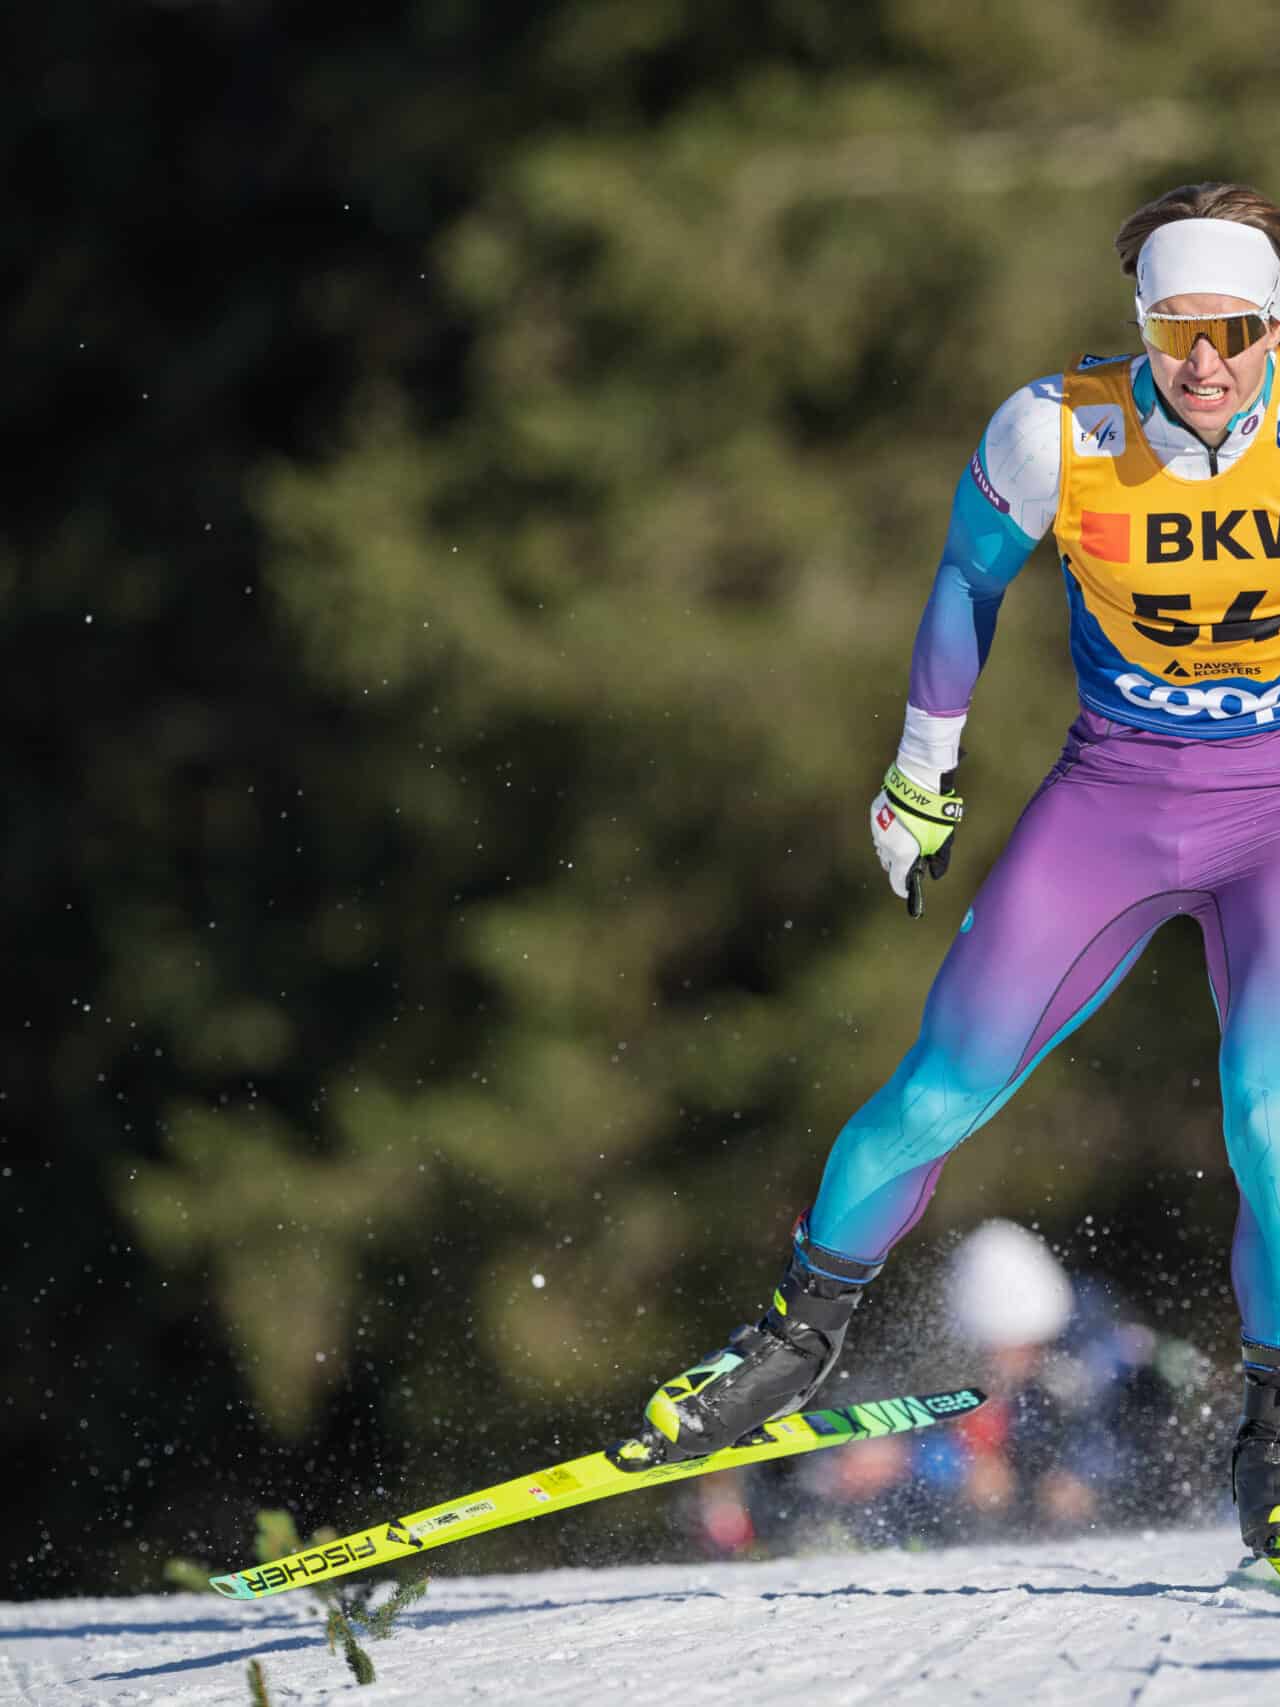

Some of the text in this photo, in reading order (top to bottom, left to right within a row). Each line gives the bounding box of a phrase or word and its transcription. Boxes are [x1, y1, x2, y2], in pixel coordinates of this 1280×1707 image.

[1193, 662, 1242, 670] DAVOS
[1194, 667, 1263, 677] KLOSTERS
[242, 1536, 377, 1593] FISCHER
